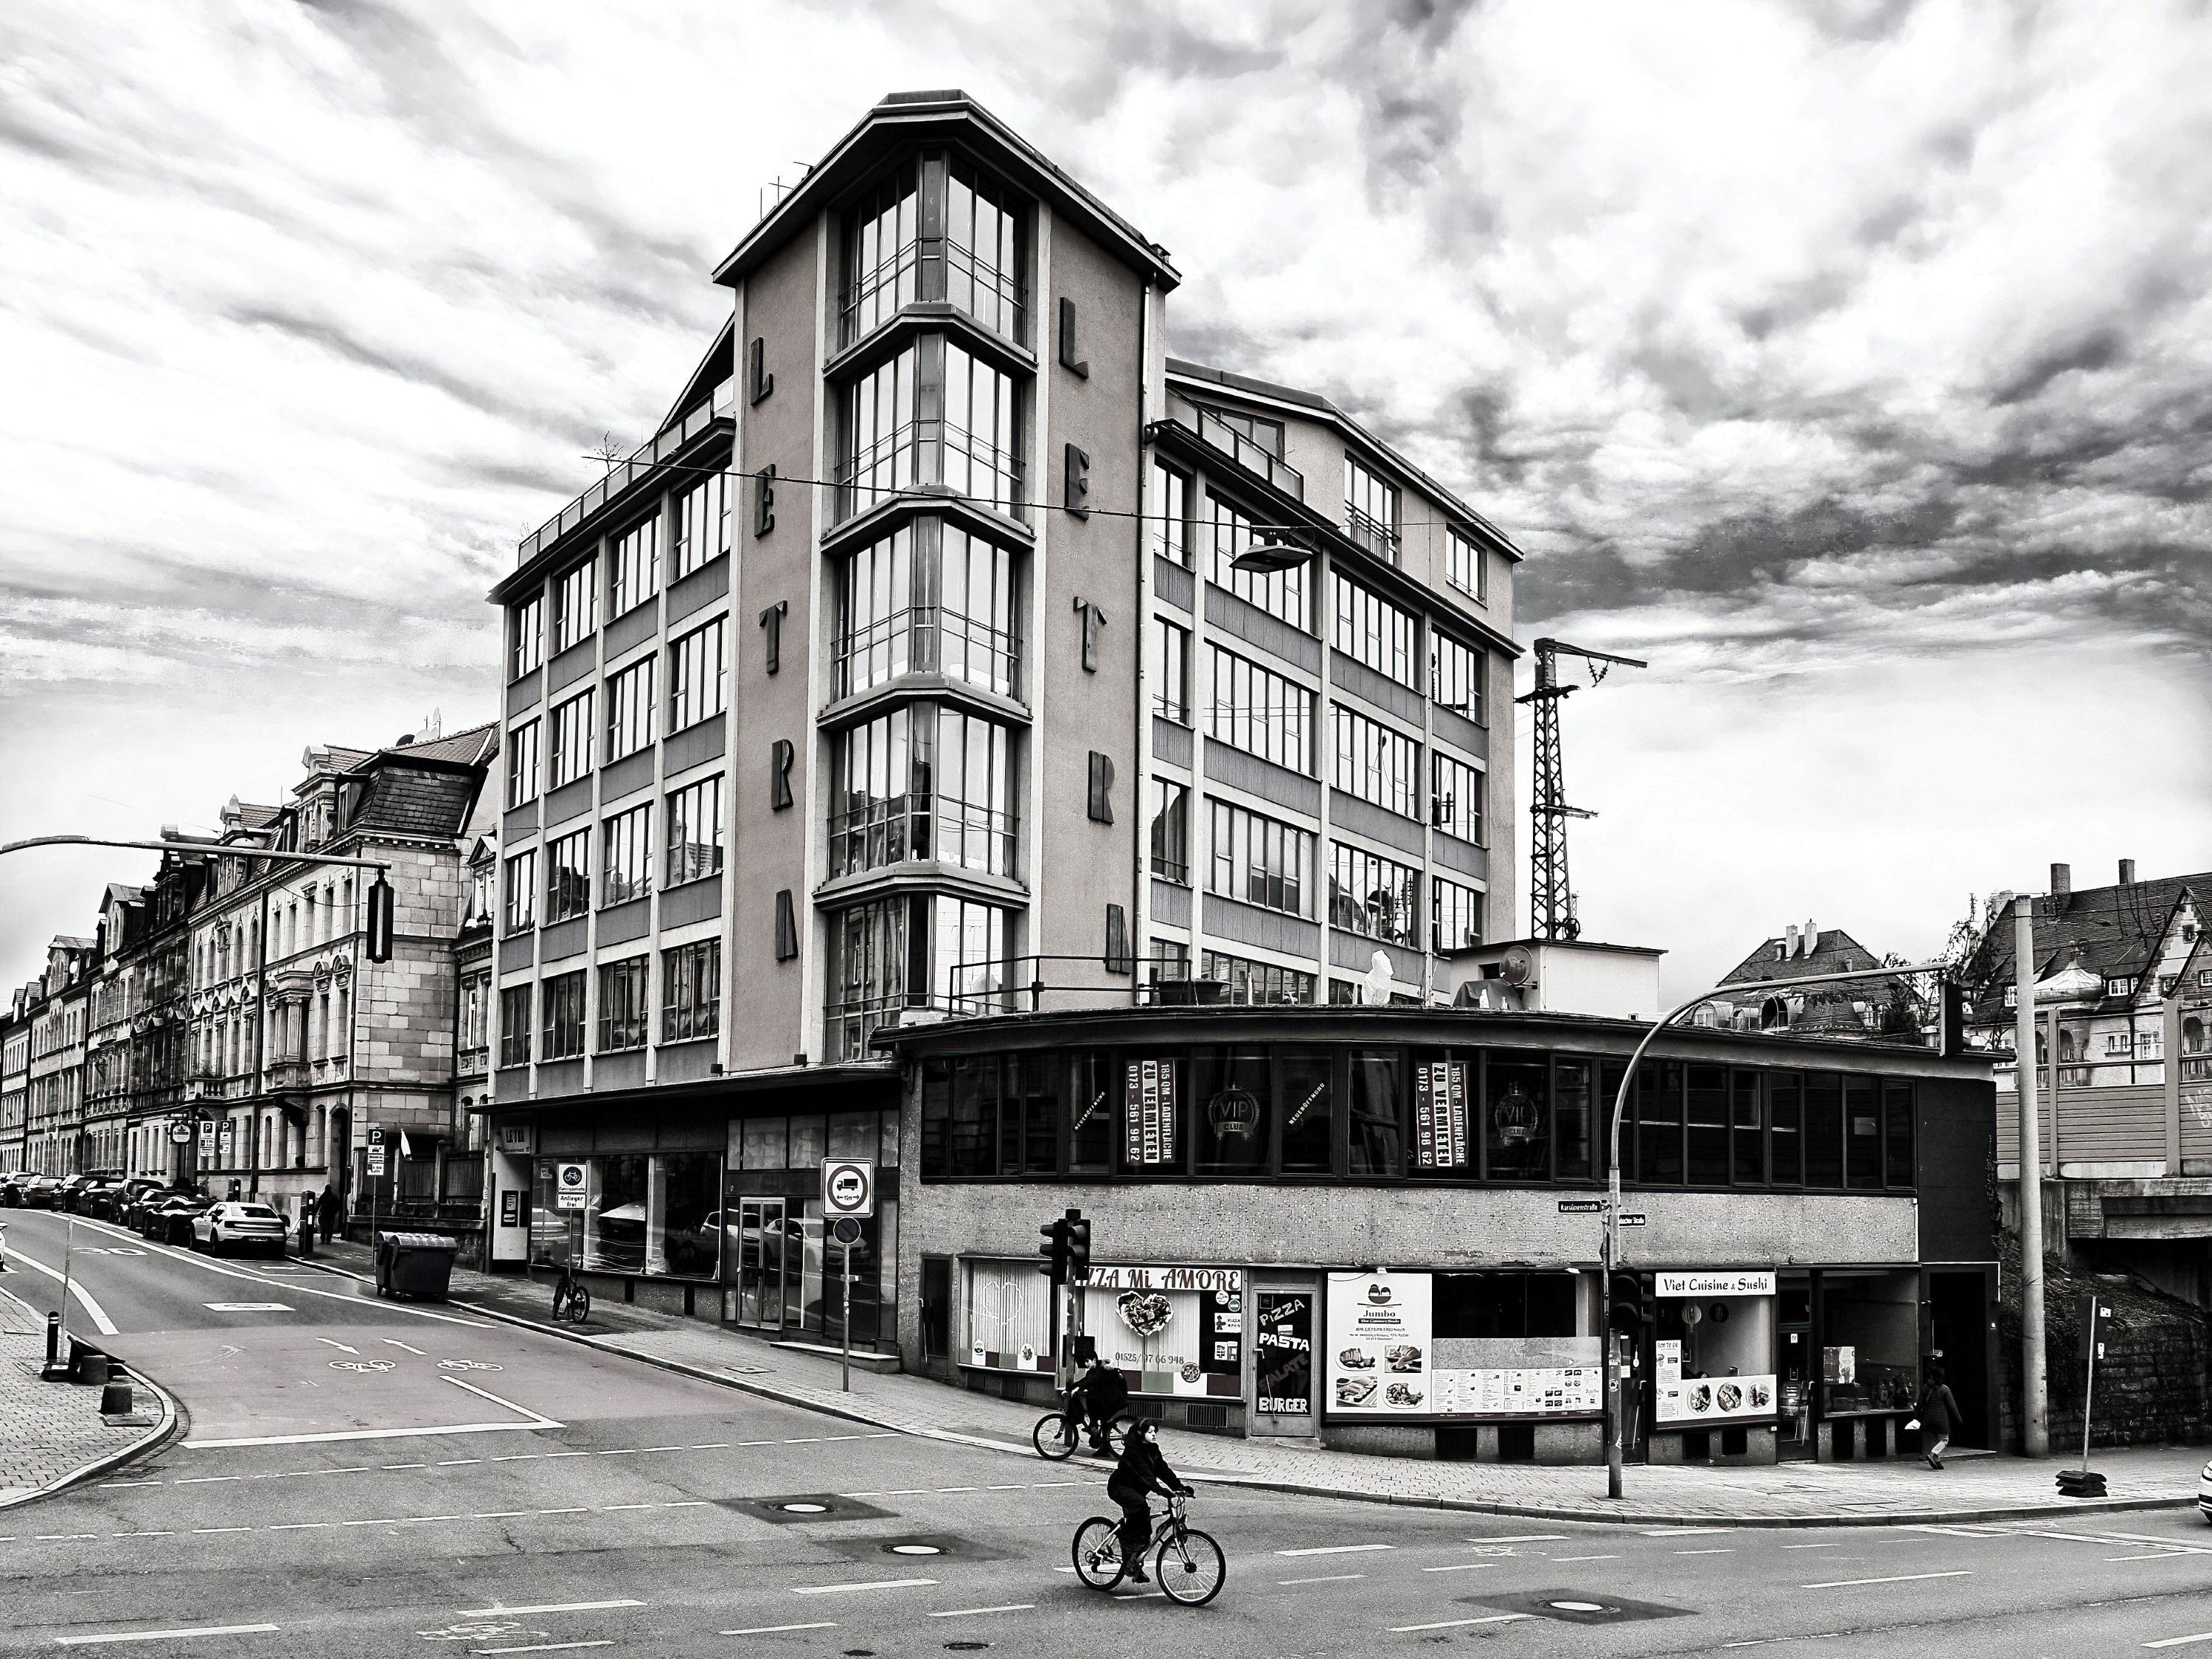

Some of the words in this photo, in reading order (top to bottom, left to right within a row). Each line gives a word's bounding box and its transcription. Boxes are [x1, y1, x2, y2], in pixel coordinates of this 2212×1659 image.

[1128, 1065, 1138, 1089] 0173
[1144, 1064, 1156, 1079] ZU
[1161, 1064, 1170, 1079] 185
[1433, 1066, 1446, 1082] ZU
[1451, 1066, 1461, 1083] 185
[1418, 1068, 1429, 1092] 0173
[1161, 1081, 1171, 1095] QM
[1451, 1085, 1462, 1098] QM
[1129, 1104, 1139, 1122] 561
[1220, 1101, 1248, 1118] VIP
[1419, 1107, 1430, 1126] 561
[1144, 1086, 1158, 1160] VERMIETEN
[1434, 1089, 1450, 1164] VERMIETEN
[372, 1131, 382, 1144] P
[1130, 1128, 1140, 1141] 98
[1420, 1131, 1431, 1146] 98
[1130, 1147, 1140, 1161] 62
[1422, 1151, 1433, 1165] 62
[72, 1247, 148, 1255] 30
[1161, 1268, 1241, 1290] AMORE
[1663, 1279, 1686, 1290] Viet
[1688, 1279, 1728, 1290] Cuisine
[1737, 1276, 1767, 1291] Sushi
[1363, 1310, 1396, 1318] Jumbo
[1259, 1332, 1310, 1352] PASTA
[1168, 1355, 1184, 1365] 948
[1259, 1397, 1308, 1413] BURGER
